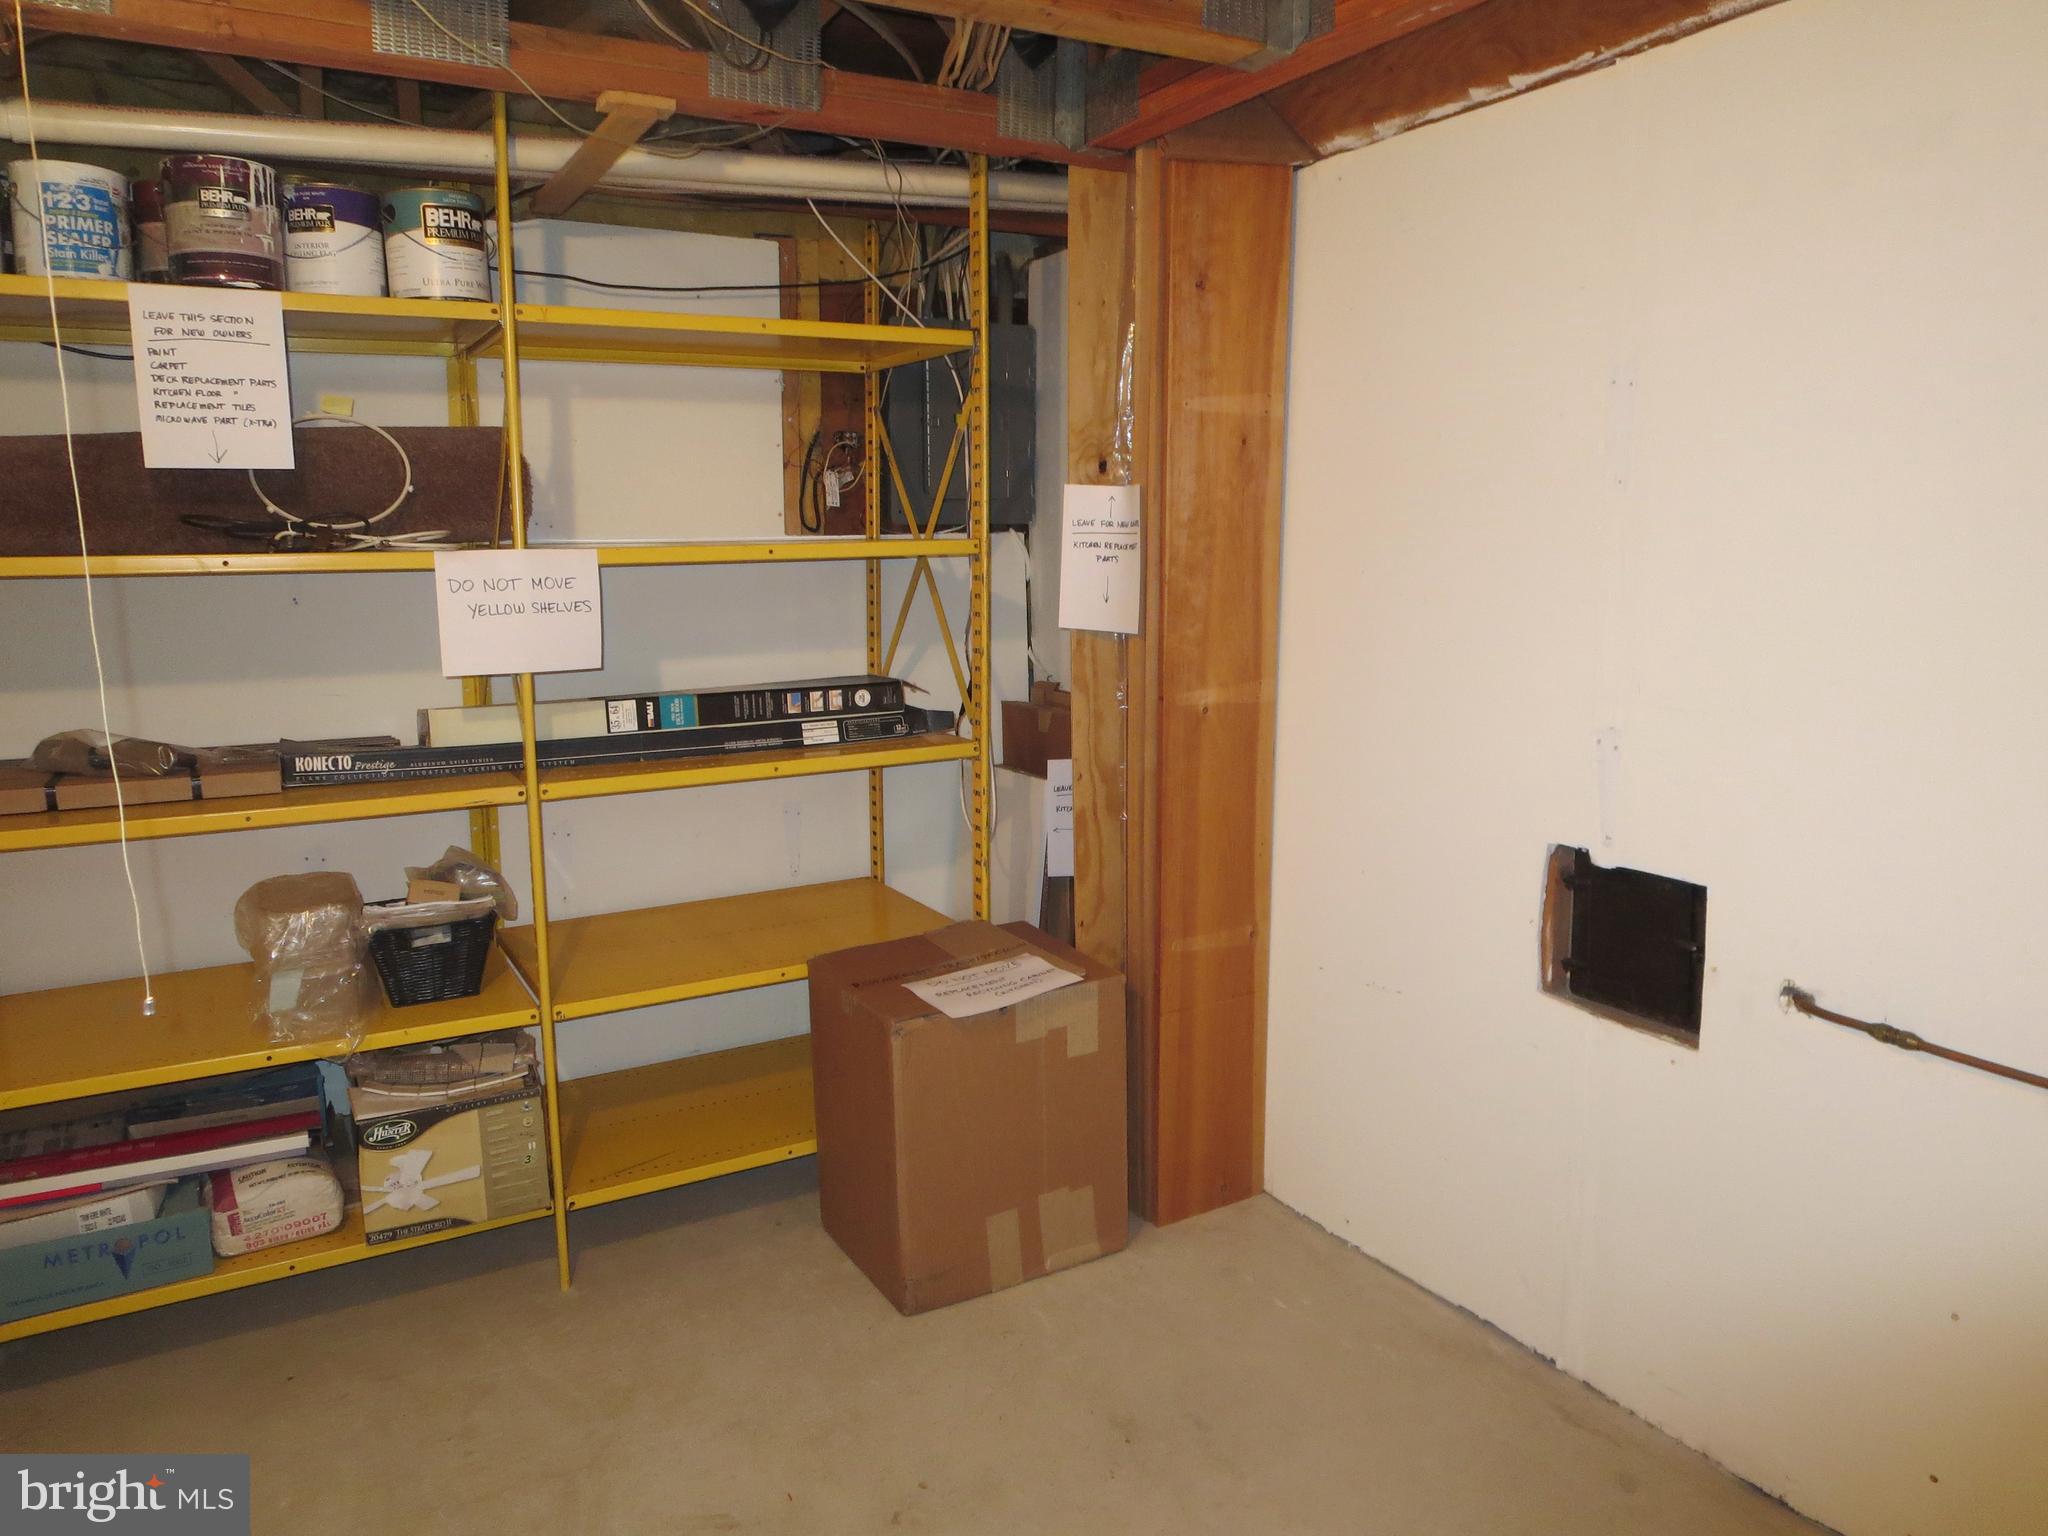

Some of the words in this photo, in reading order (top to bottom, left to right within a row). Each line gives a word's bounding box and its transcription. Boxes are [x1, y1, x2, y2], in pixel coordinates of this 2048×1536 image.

[200, 189, 234, 203] BEHR
[200, 201, 232, 211] PREMIUM
[288, 207, 317, 221] BEHR
[424, 207, 473, 231] BEHR
[44, 214, 113, 236] PRIMER
[288, 220, 314, 228] PREMIUM
[315, 220, 331, 228] PLUS
[426, 227, 470, 240] PREMIUM
[294, 241, 330, 250] INTERIOR
[48, 247, 77, 259] Stain
[422, 277, 450, 286] ULTRA
[454, 277, 475, 289] PURE
[143, 310, 175, 320] LEAVE
[179, 312, 206, 323] THIS
[210, 314, 254, 325] SECTION
[154, 327, 173, 336] FOR
[182, 327, 205, 337] NEW
[213, 329, 253, 340] OWNERS
[147, 347, 177, 356] PAINT
[150, 361, 187, 370] CARPET
[151, 374, 179, 384] DECK
[181, 375, 246, 387] REPLACEMENT
[250, 377, 277, 388] PARTS
[153, 387, 191, 397] KITCHEN
[195, 389, 222, 398] FLOOR
[154, 401, 225, 410] REPLACEMENT
[232, 403, 256, 412] TILES
[155, 415, 208, 425] MICROWAVE
[213, 416, 239, 425] PART
[1072, 519, 1096, 527] LEAVE
[1100, 519, 1114, 528] FOR
[1095, 554, 1119, 563] PARTS
[447, 577, 474, 594] DO
[483, 577, 522, 593] NOT
[531, 576, 577, 591] MOVE
[467, 602, 526, 620] YELLOW
[531, 600, 593, 614] SHELVES
[295, 755, 352, 772] KONECTO
[354, 759, 397, 775] Prestige
[334, 772, 395, 781] COLLECTION
[542, 759, 576, 767] SYSTEM
[238, 1168, 267, 1184] CAUTION
